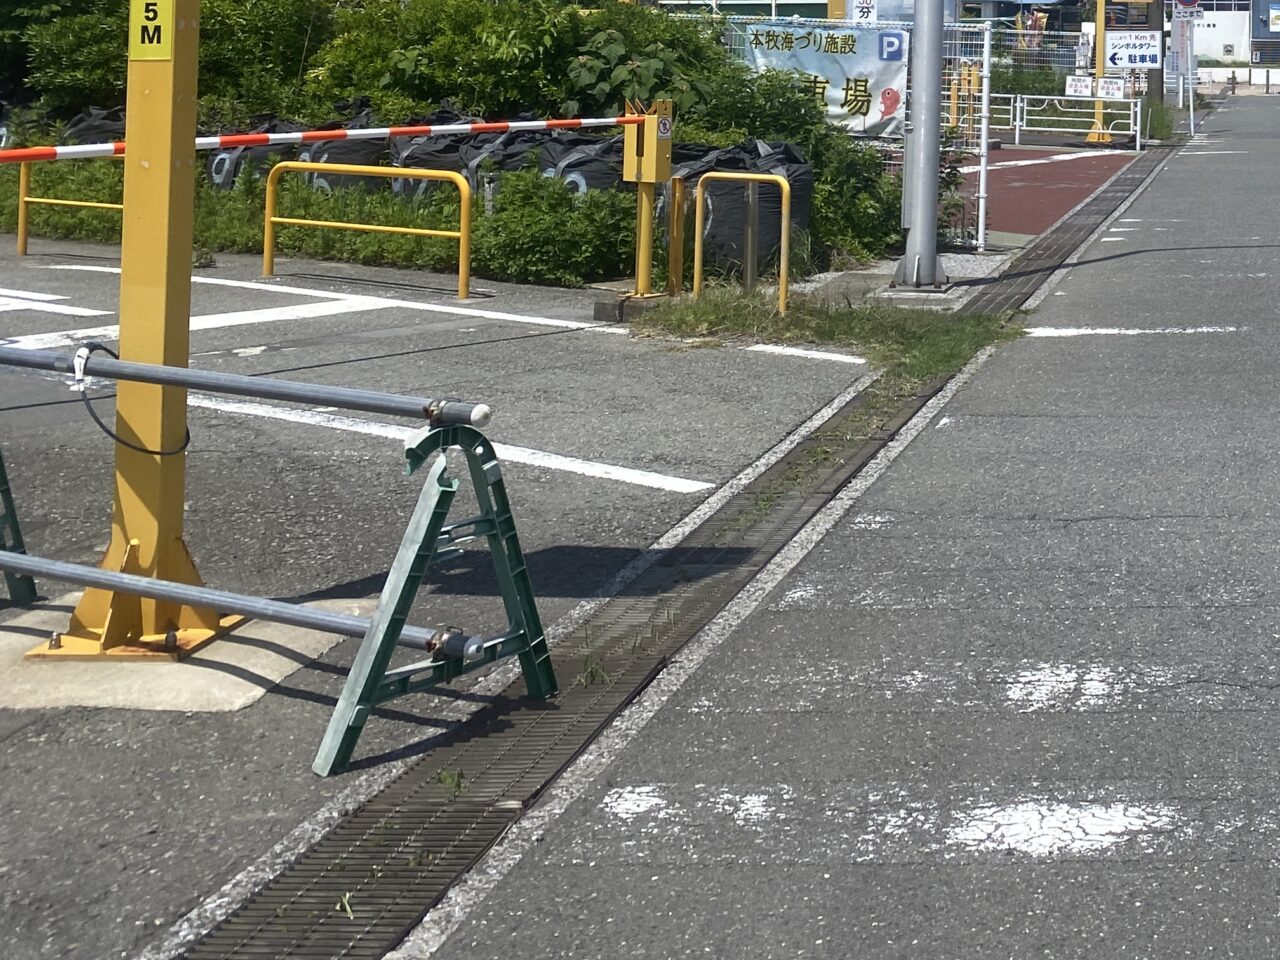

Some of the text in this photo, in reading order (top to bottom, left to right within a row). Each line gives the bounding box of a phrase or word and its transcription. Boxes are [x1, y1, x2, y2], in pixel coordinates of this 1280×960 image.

[1175, 10, 1202, 19] ここまで
[750, 29, 857, 55] 本牧海づり施設
[1111, 42, 1157, 50] シンボルタワー
[882, 37, 900, 59] P
[1128, 53, 1158, 64] 駐車場
